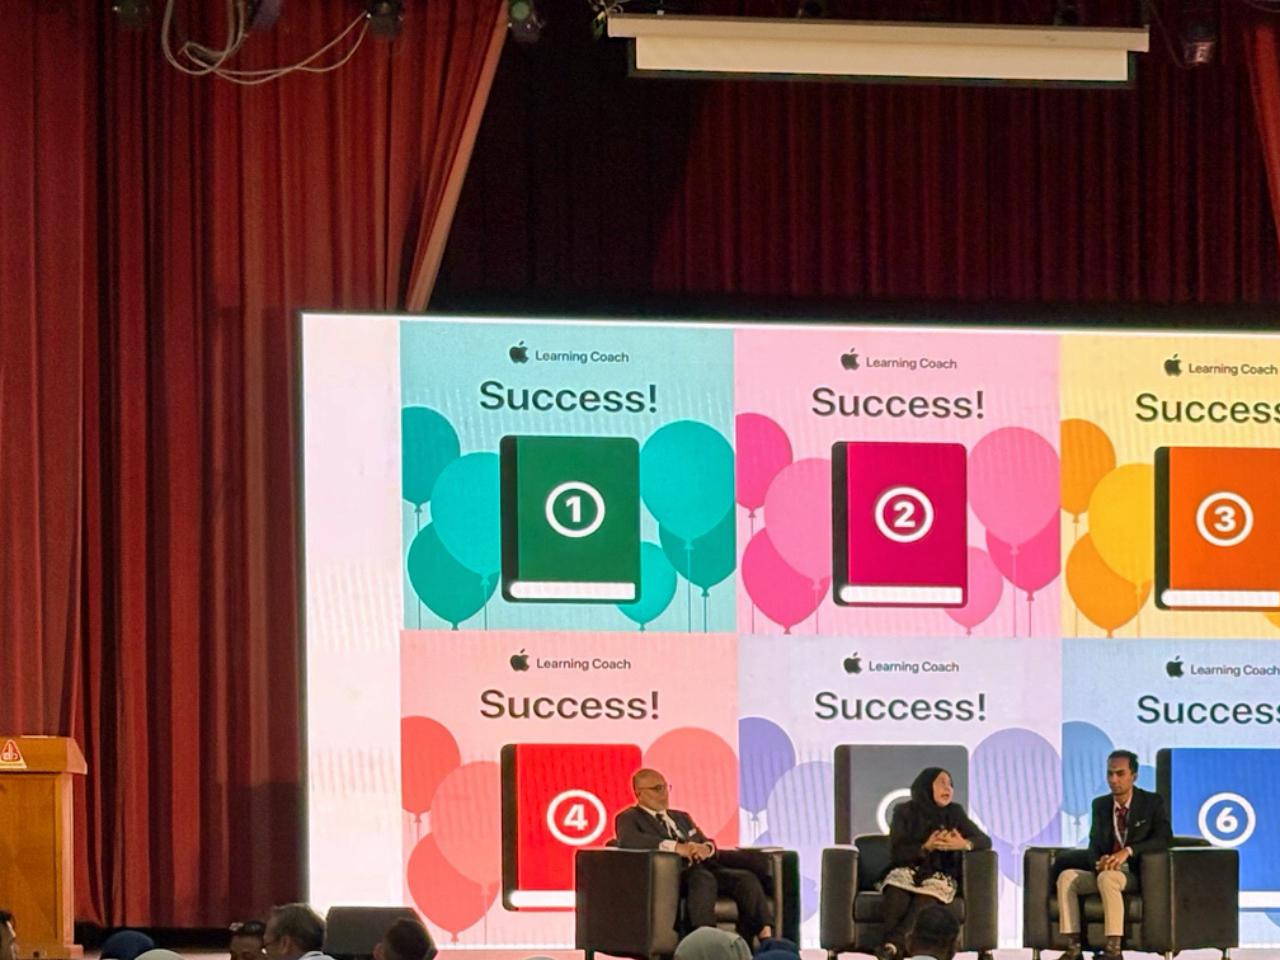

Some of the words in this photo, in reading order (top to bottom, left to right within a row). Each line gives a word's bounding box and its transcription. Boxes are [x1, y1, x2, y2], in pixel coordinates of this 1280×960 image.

[535, 350, 588, 365] Learning
[590, 351, 630, 363] Coach
[866, 356, 918, 371] Learning
[919, 357, 958, 369] Coach
[1188, 363, 1239, 377] Learning
[1240, 364, 1279, 376] Coach
[480, 380, 657, 414] Success!
[812, 387, 984, 420] Success!
[565, 495, 581, 523] 1
[893, 500, 916, 528] 2
[1214, 505, 1236, 532] 3
[536, 658, 590, 672] Learning
[591, 659, 632, 671] Coach
[868, 660, 920, 675] Learning
[921, 661, 960, 673] Coach
[1190, 664, 1241, 678] Learning
[1242, 665, 1280, 677] Coach
[480, 689, 659, 720] Success!
[815, 691, 986, 722] Success!
[563, 804, 588, 831] 4
[1215, 806, 1239, 834] 6
